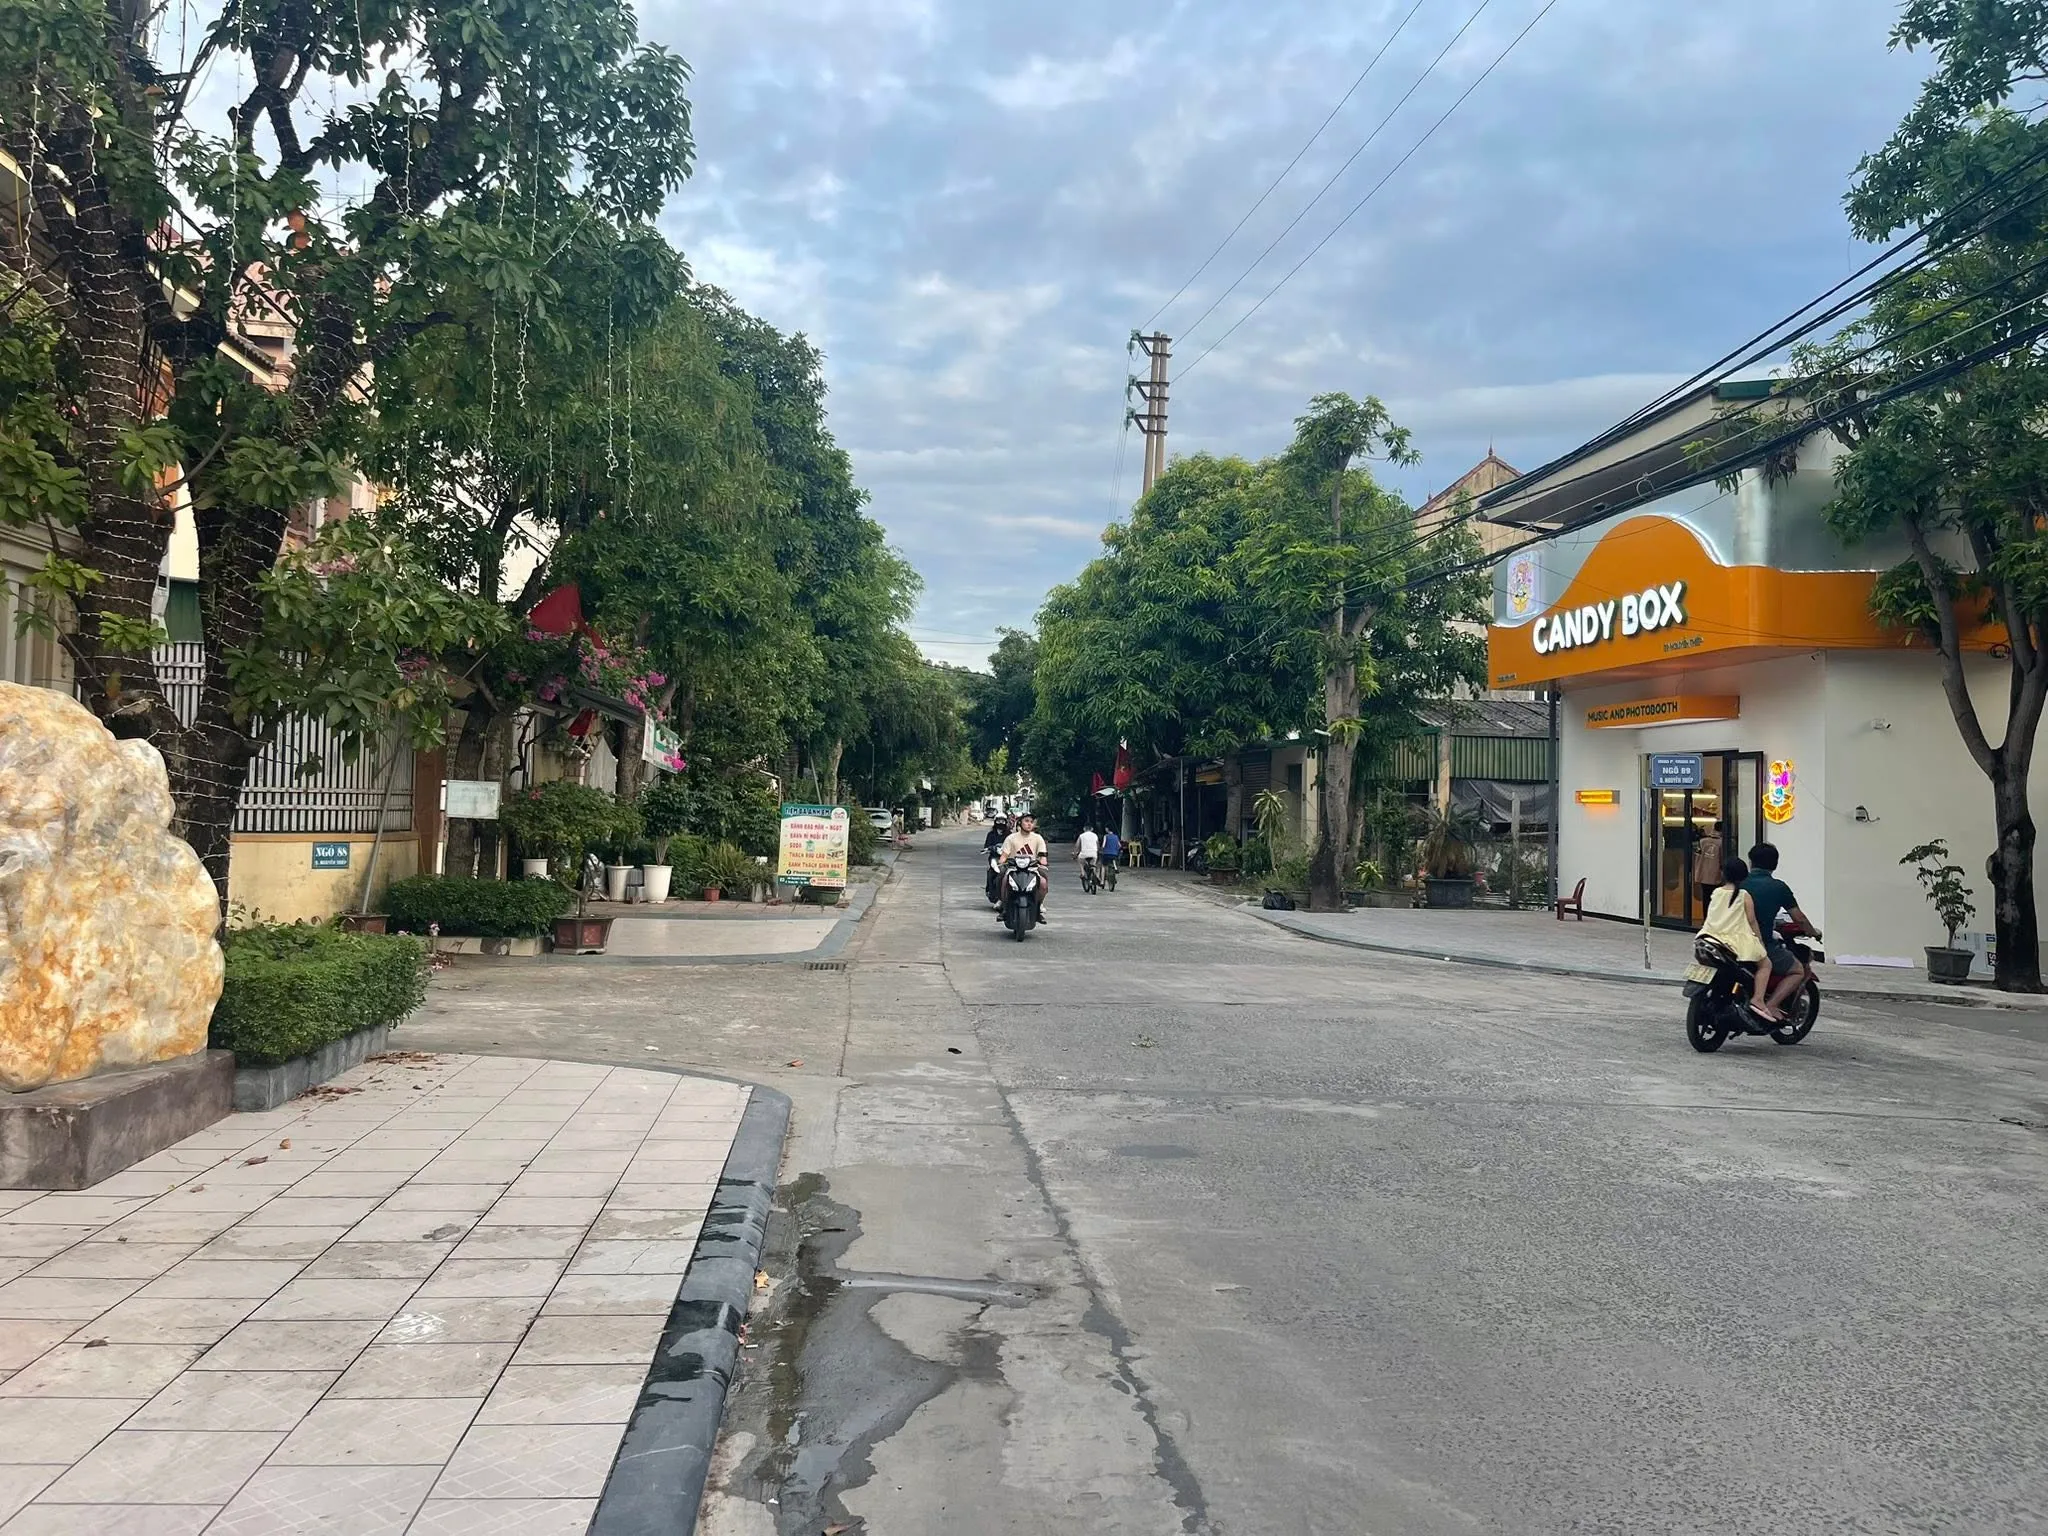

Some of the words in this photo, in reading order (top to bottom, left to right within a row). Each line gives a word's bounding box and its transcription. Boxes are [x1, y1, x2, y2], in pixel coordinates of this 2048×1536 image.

[1533, 600, 1615, 654] CANDY
[1621, 581, 1684, 636] BOX
[1587, 710, 1608, 721] MUSIC
[1610, 708, 1624, 719] AND
[1625, 702, 1678, 718] PHOTOBOOTH
[337, 847, 348, 857] 88
